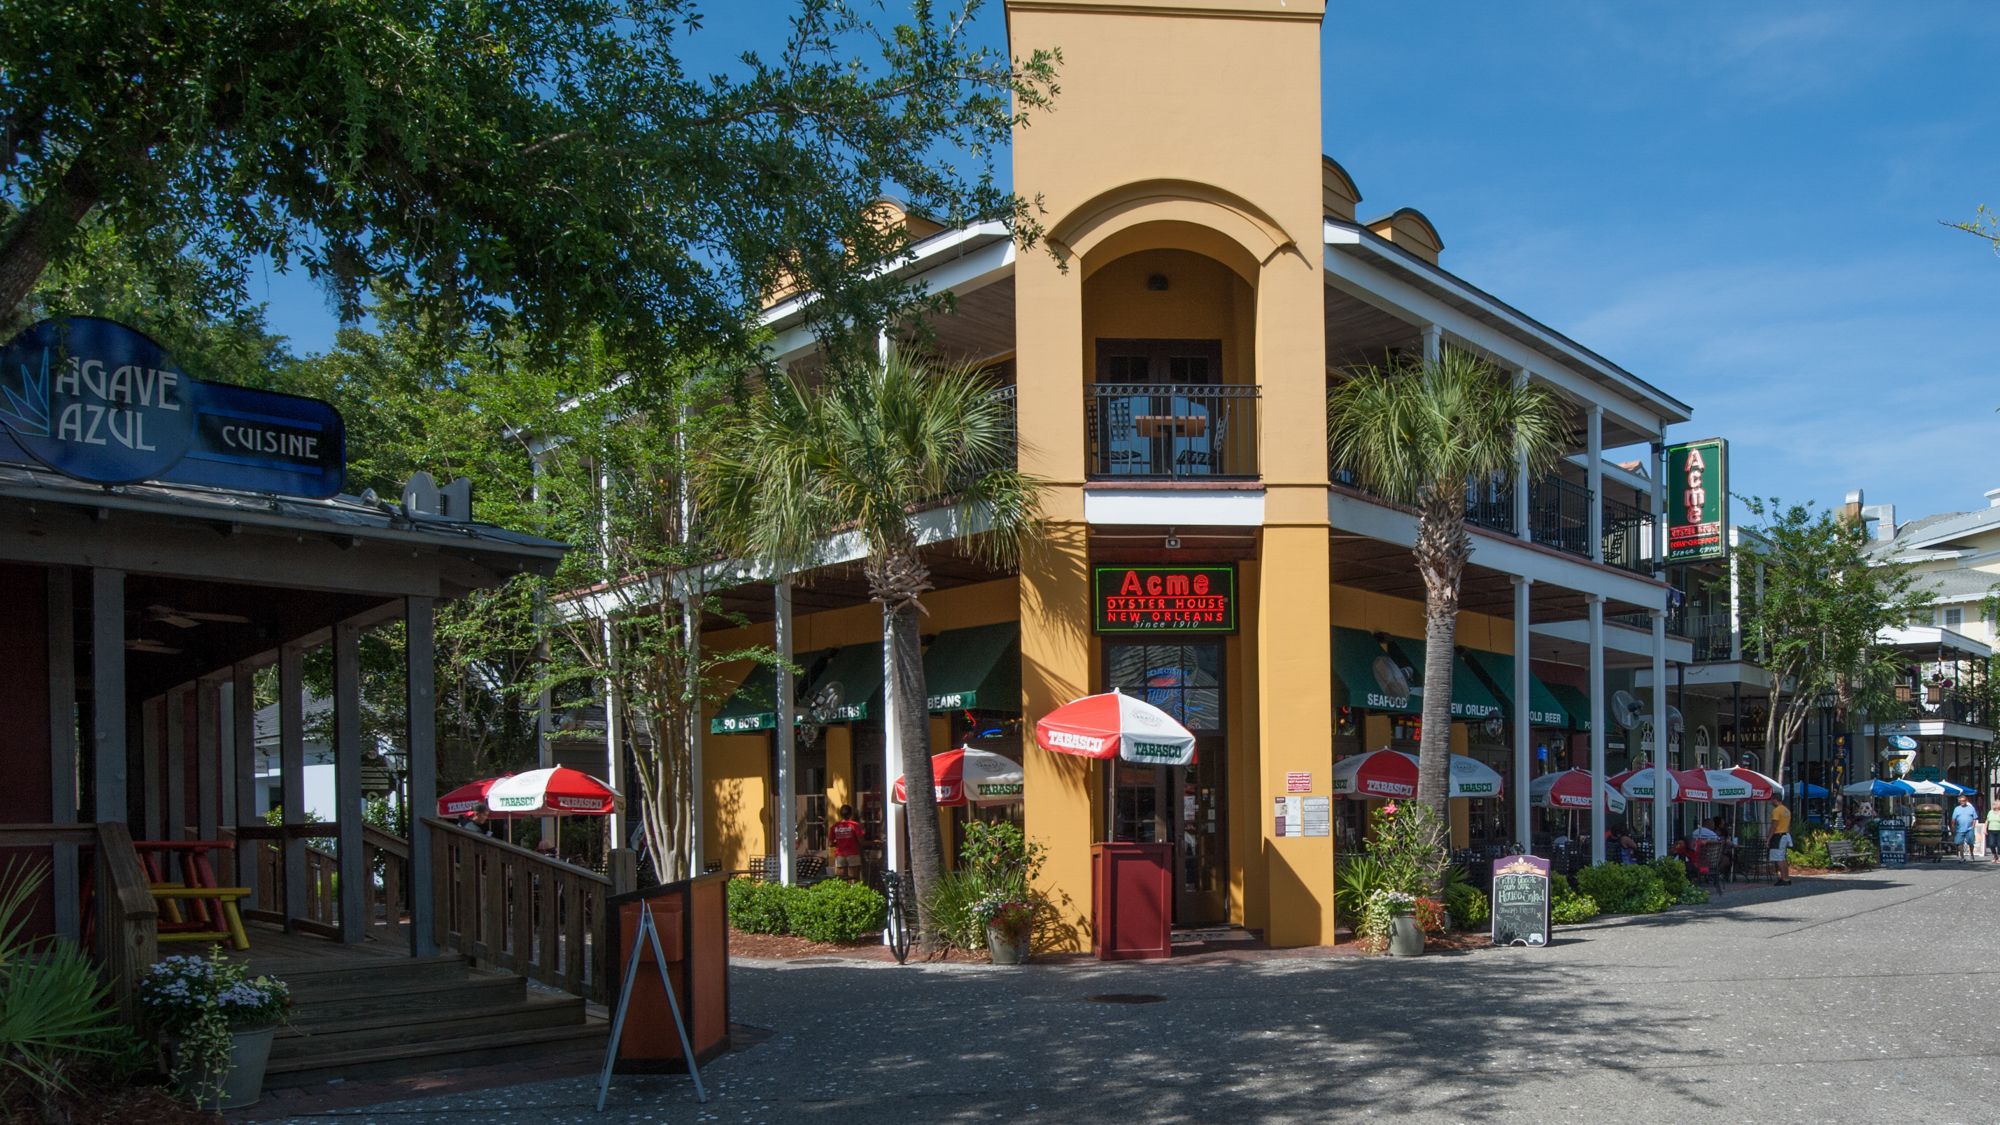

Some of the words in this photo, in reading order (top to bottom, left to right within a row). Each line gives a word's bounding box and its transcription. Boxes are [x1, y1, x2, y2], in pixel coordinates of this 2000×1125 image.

[55, 357, 180, 411] AGAVE
[58, 404, 156, 452] AZUL
[222, 425, 319, 459] CUISINE
[1120, 570, 1209, 596] Acme
[1107, 598, 1165, 609] OYSTER
[1176, 598, 1224, 609] HOUSE
[1107, 612, 1140, 621] NEW
[1152, 612, 1223, 622] ORLEANS
[1133, 620, 1166, 628] Since
[1172, 620, 1199, 628] 1910
[927, 694, 962, 709] BEANS
[1367, 693, 1408, 709] SEAFOOD
[820, 706, 860, 720] OYSTERS
[1451, 704, 1463, 714] EW
[738, 717, 760, 729] BOYS
[1530, 712, 1542, 722] OLD
[1545, 713, 1561, 724] BEER
[1047, 730, 1104, 752] TABASCO
[1134, 742, 1182, 758] TABASCO
[978, 783, 1024, 796] TABASCO
[1367, 779, 1415, 795] TABASCO
[1633, 787, 1655, 796] TABA
[499, 796, 536, 807] TABASCO
[558, 796, 603, 809] TABASCO
[1560, 795, 1593, 805] TABASC
